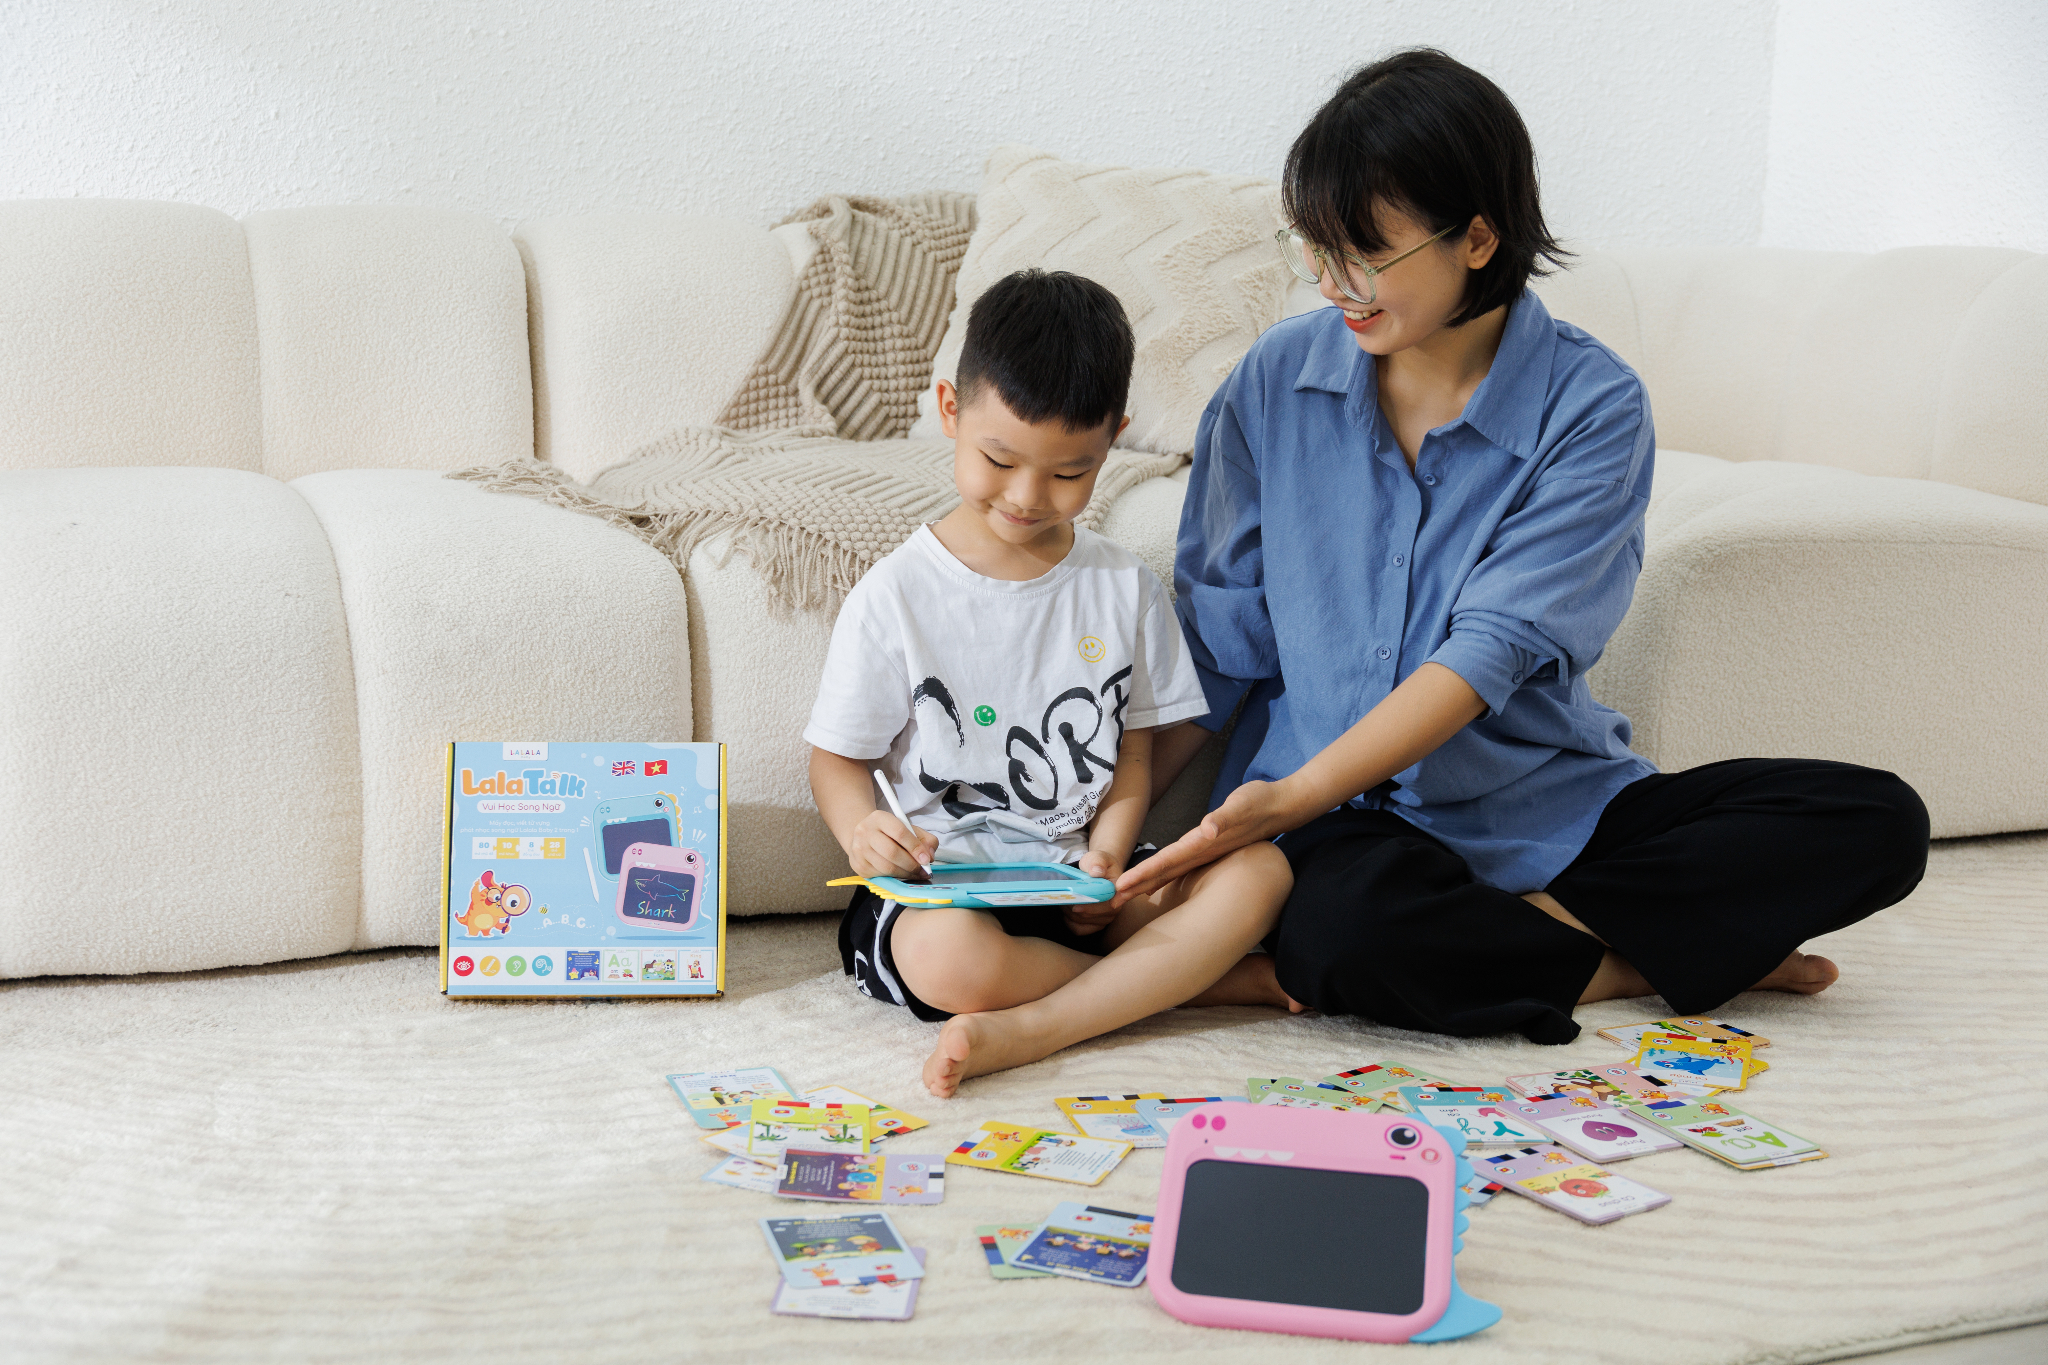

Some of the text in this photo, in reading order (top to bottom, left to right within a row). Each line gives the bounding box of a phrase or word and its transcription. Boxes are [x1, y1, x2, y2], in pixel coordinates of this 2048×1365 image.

[482, 803, 562, 813] Vui Học Song Ngữ
[636, 900, 677, 919] Shark
[561, 914, 570, 925] B
[575, 917, 586, 928] C
